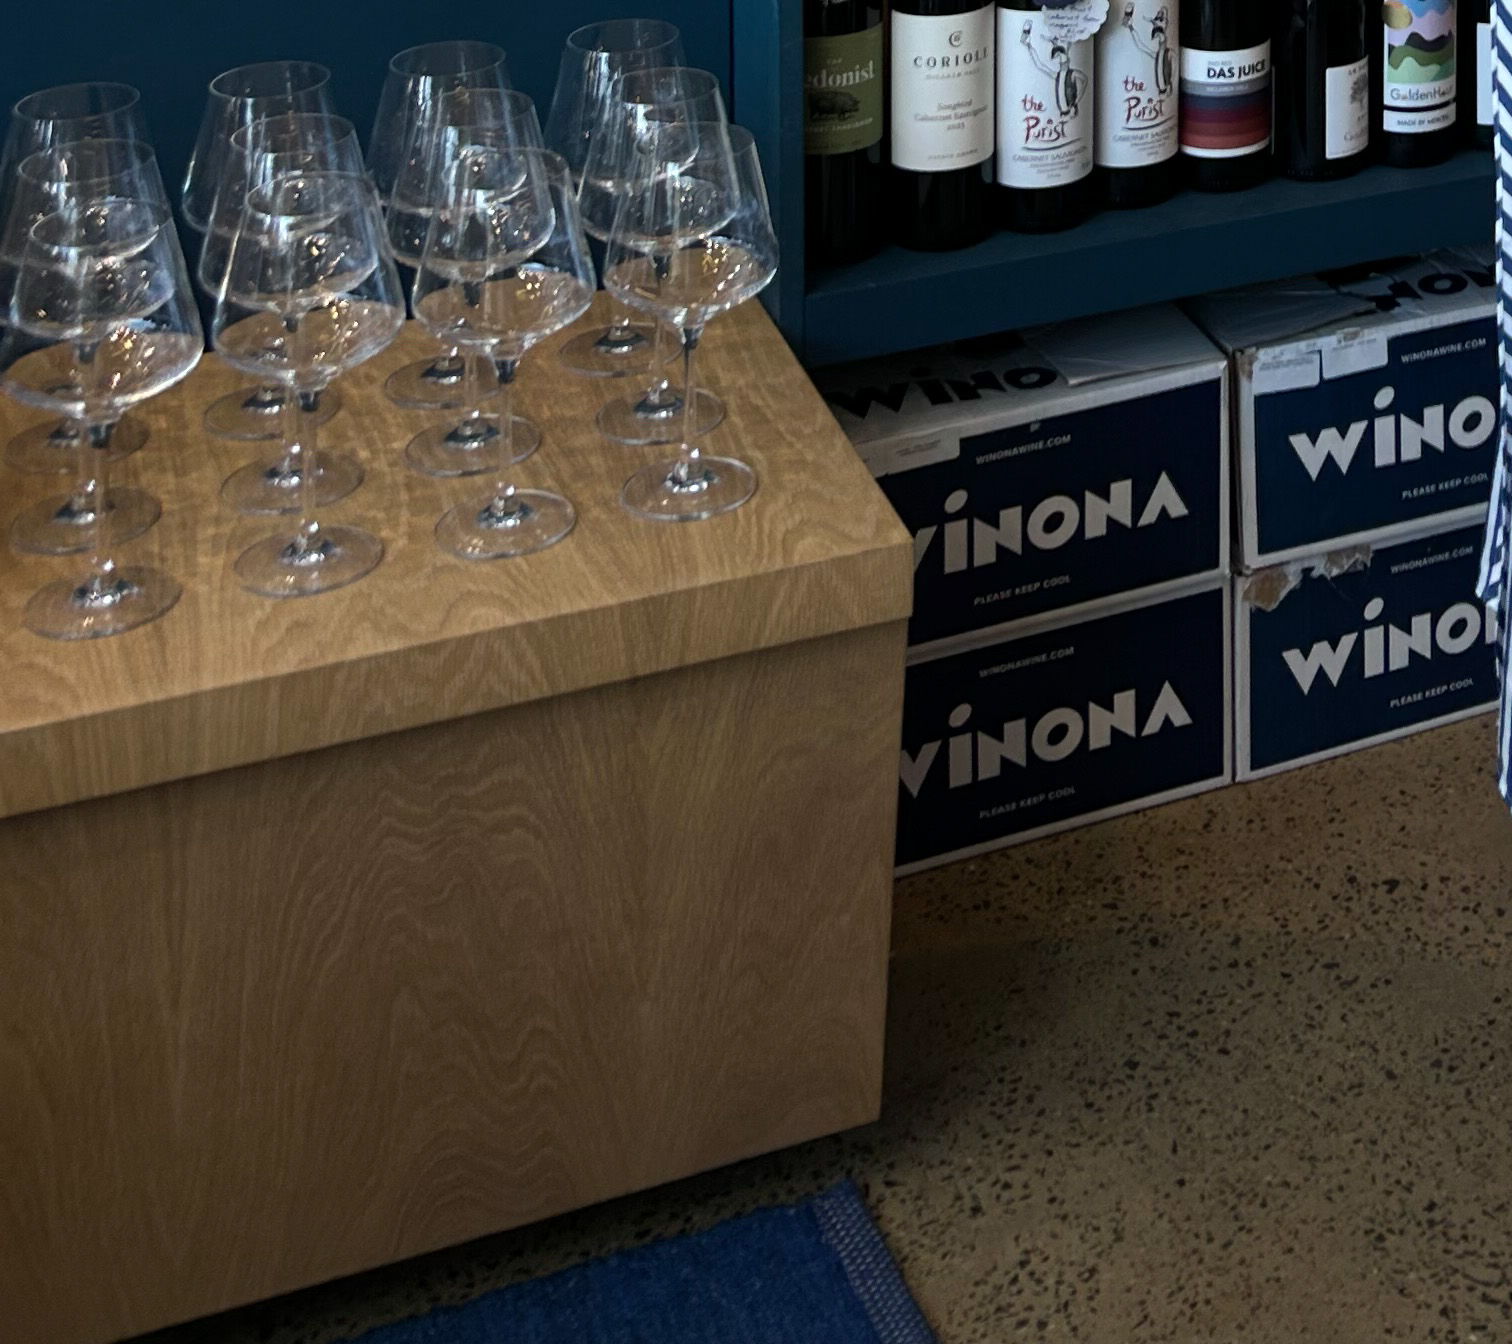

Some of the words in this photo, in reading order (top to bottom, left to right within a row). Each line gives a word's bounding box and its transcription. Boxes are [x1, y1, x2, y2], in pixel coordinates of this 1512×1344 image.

[806, 61, 876, 92] edonist
[1121, 75, 1147, 94] the
[1207, 65, 1234, 80] DAS
[1237, 59, 1267, 79] JUICE
[1021, 94, 1048, 113] the
[1024, 118, 1070, 143] Purist
[1402, 483, 1437, 502] PLEASE
[1438, 478, 1463, 492] KEEP
[1463, 472, 1490, 487] COOL
[972, 590, 1012, 608] PLEASE
[1014, 582, 1044, 599] KEEP
[1044, 574, 1072, 591] COOL
[1389, 692, 1423, 709] PLEASE
[1424, 685, 1448, 701] KEEP
[1449, 677, 1474, 694] COOL
[978, 802, 1017, 820] PLEASE
[1018, 794, 1048, 811] KEEP
[1048, 784, 1077, 802] COOL
